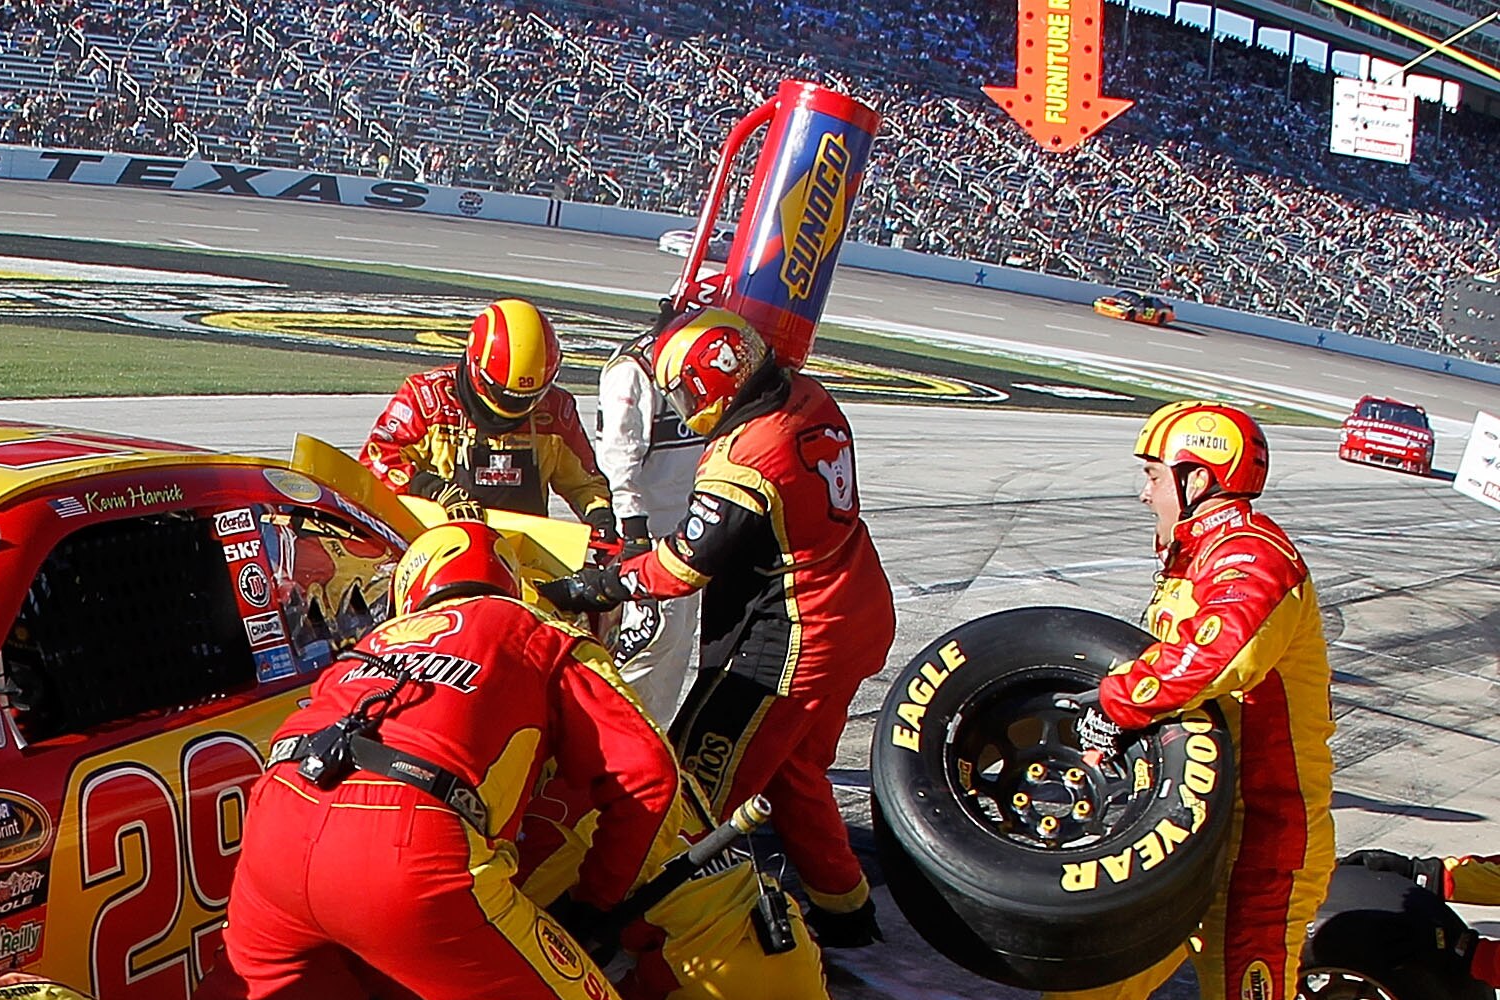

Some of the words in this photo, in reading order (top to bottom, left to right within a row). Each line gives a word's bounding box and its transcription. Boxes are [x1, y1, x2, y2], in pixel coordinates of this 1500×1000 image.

[1044, 13, 1070, 124] FURNITURE
[41, 151, 430, 209] TEXAS
[785, 138, 852, 294] SUNOCO
[518, 377, 534, 388] 29
[84, 488, 126, 513] Kevin
[126, 483, 185, 510] Harvick
[223, 540, 261, 562] SKF
[1161, 643, 1199, 681] hell
[892, 640, 967, 753] EAGLE
[13, 840, 42, 856] SERIES
[541, 924, 579, 969] PENNZOIL
